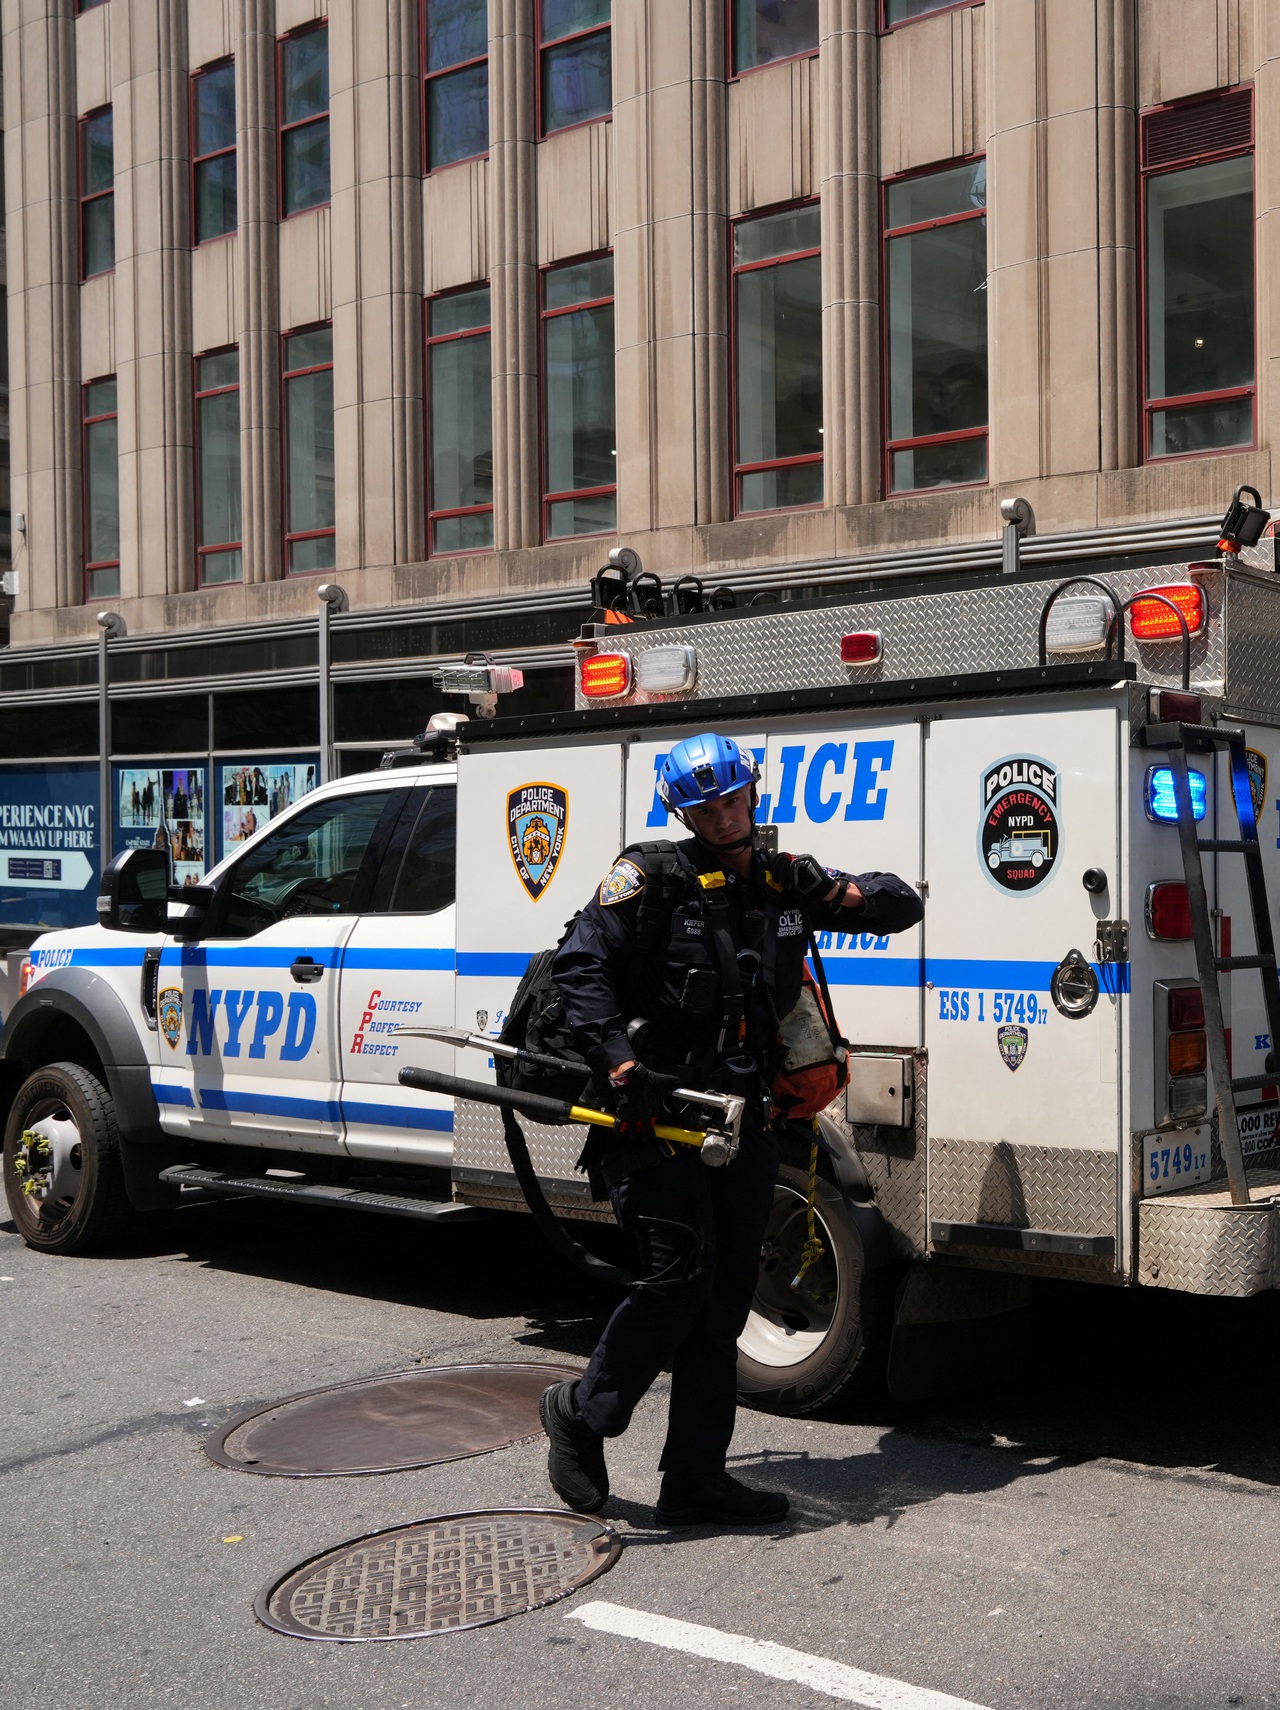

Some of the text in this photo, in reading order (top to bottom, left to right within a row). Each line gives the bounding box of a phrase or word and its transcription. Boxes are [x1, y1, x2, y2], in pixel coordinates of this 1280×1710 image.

[986, 763, 1055, 801] POLICE
[521, 788, 554, 803] POLICE
[0, 805, 95, 829] ERIENCE NYC
[510, 800, 565, 823] DEPARTMENT
[988, 792, 1053, 827] EMERGENCY
[1008, 815, 1034, 827] NYPD
[9, 830, 47, 848] WAAAY
[48, 831, 62, 848] UP
[64, 831, 95, 849] HERE
[511, 835, 530, 881] CITY OF
[540, 827, 565, 887] NEW YORK
[1007, 869, 1035, 880] SQUAD
[683, 919, 705, 927] KIEFER
[38, 949, 74, 967] POLICE
[368, 990, 422, 1013] COURTESY
[939, 991, 969, 1021] ESS
[978, 992, 984, 1021] 1
[186, 989, 317, 1061] NYPD
[350, 1033, 398, 1057] RESPECT
[431, 1549, 461, 1608] SEWER
